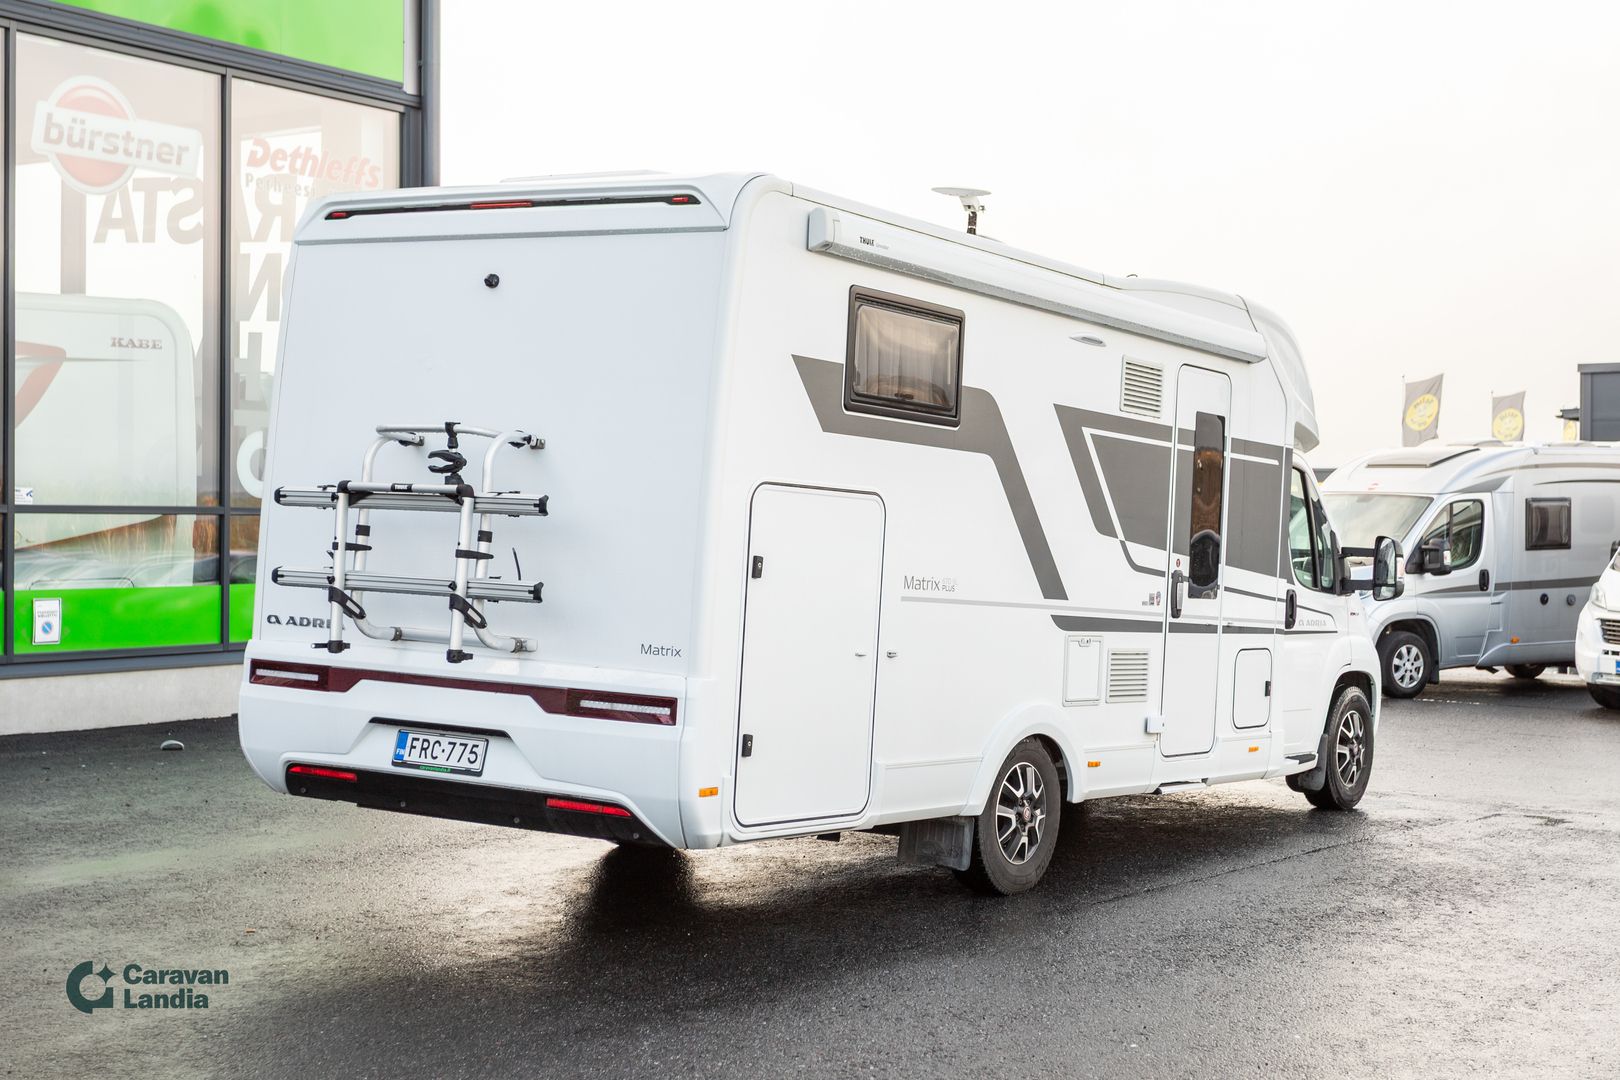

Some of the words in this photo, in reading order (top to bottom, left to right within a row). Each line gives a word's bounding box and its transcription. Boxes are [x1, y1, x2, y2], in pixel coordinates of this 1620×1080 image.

[43, 112, 190, 167] bürstner
[246, 136, 382, 188] Dethleffs
[859, 236, 875, 247] THULE
[111, 337, 163, 350] KABE
[903, 575, 940, 591] Matrix
[285, 616, 345, 630] ADRI
[640, 643, 682, 658] Matrix
